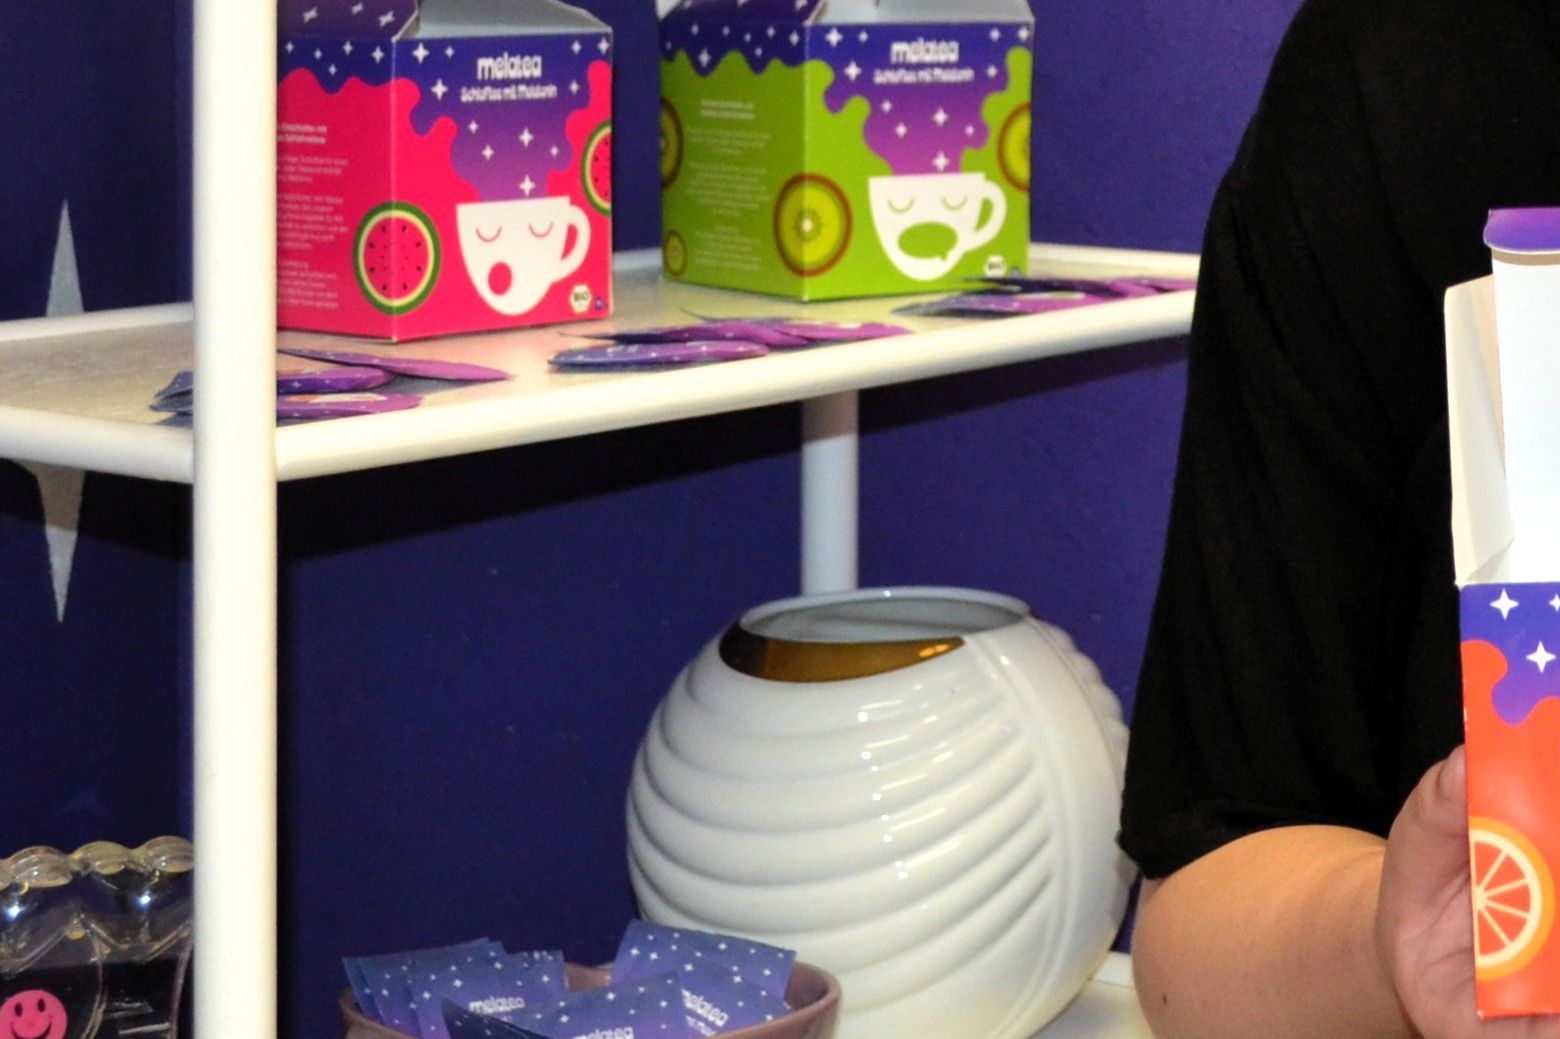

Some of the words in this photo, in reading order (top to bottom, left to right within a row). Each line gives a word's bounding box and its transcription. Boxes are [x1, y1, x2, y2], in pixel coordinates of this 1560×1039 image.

[891, 36, 960, 65] melatea
[477, 51, 542, 81] melatea
[469, 996, 525, 1015] melatea
